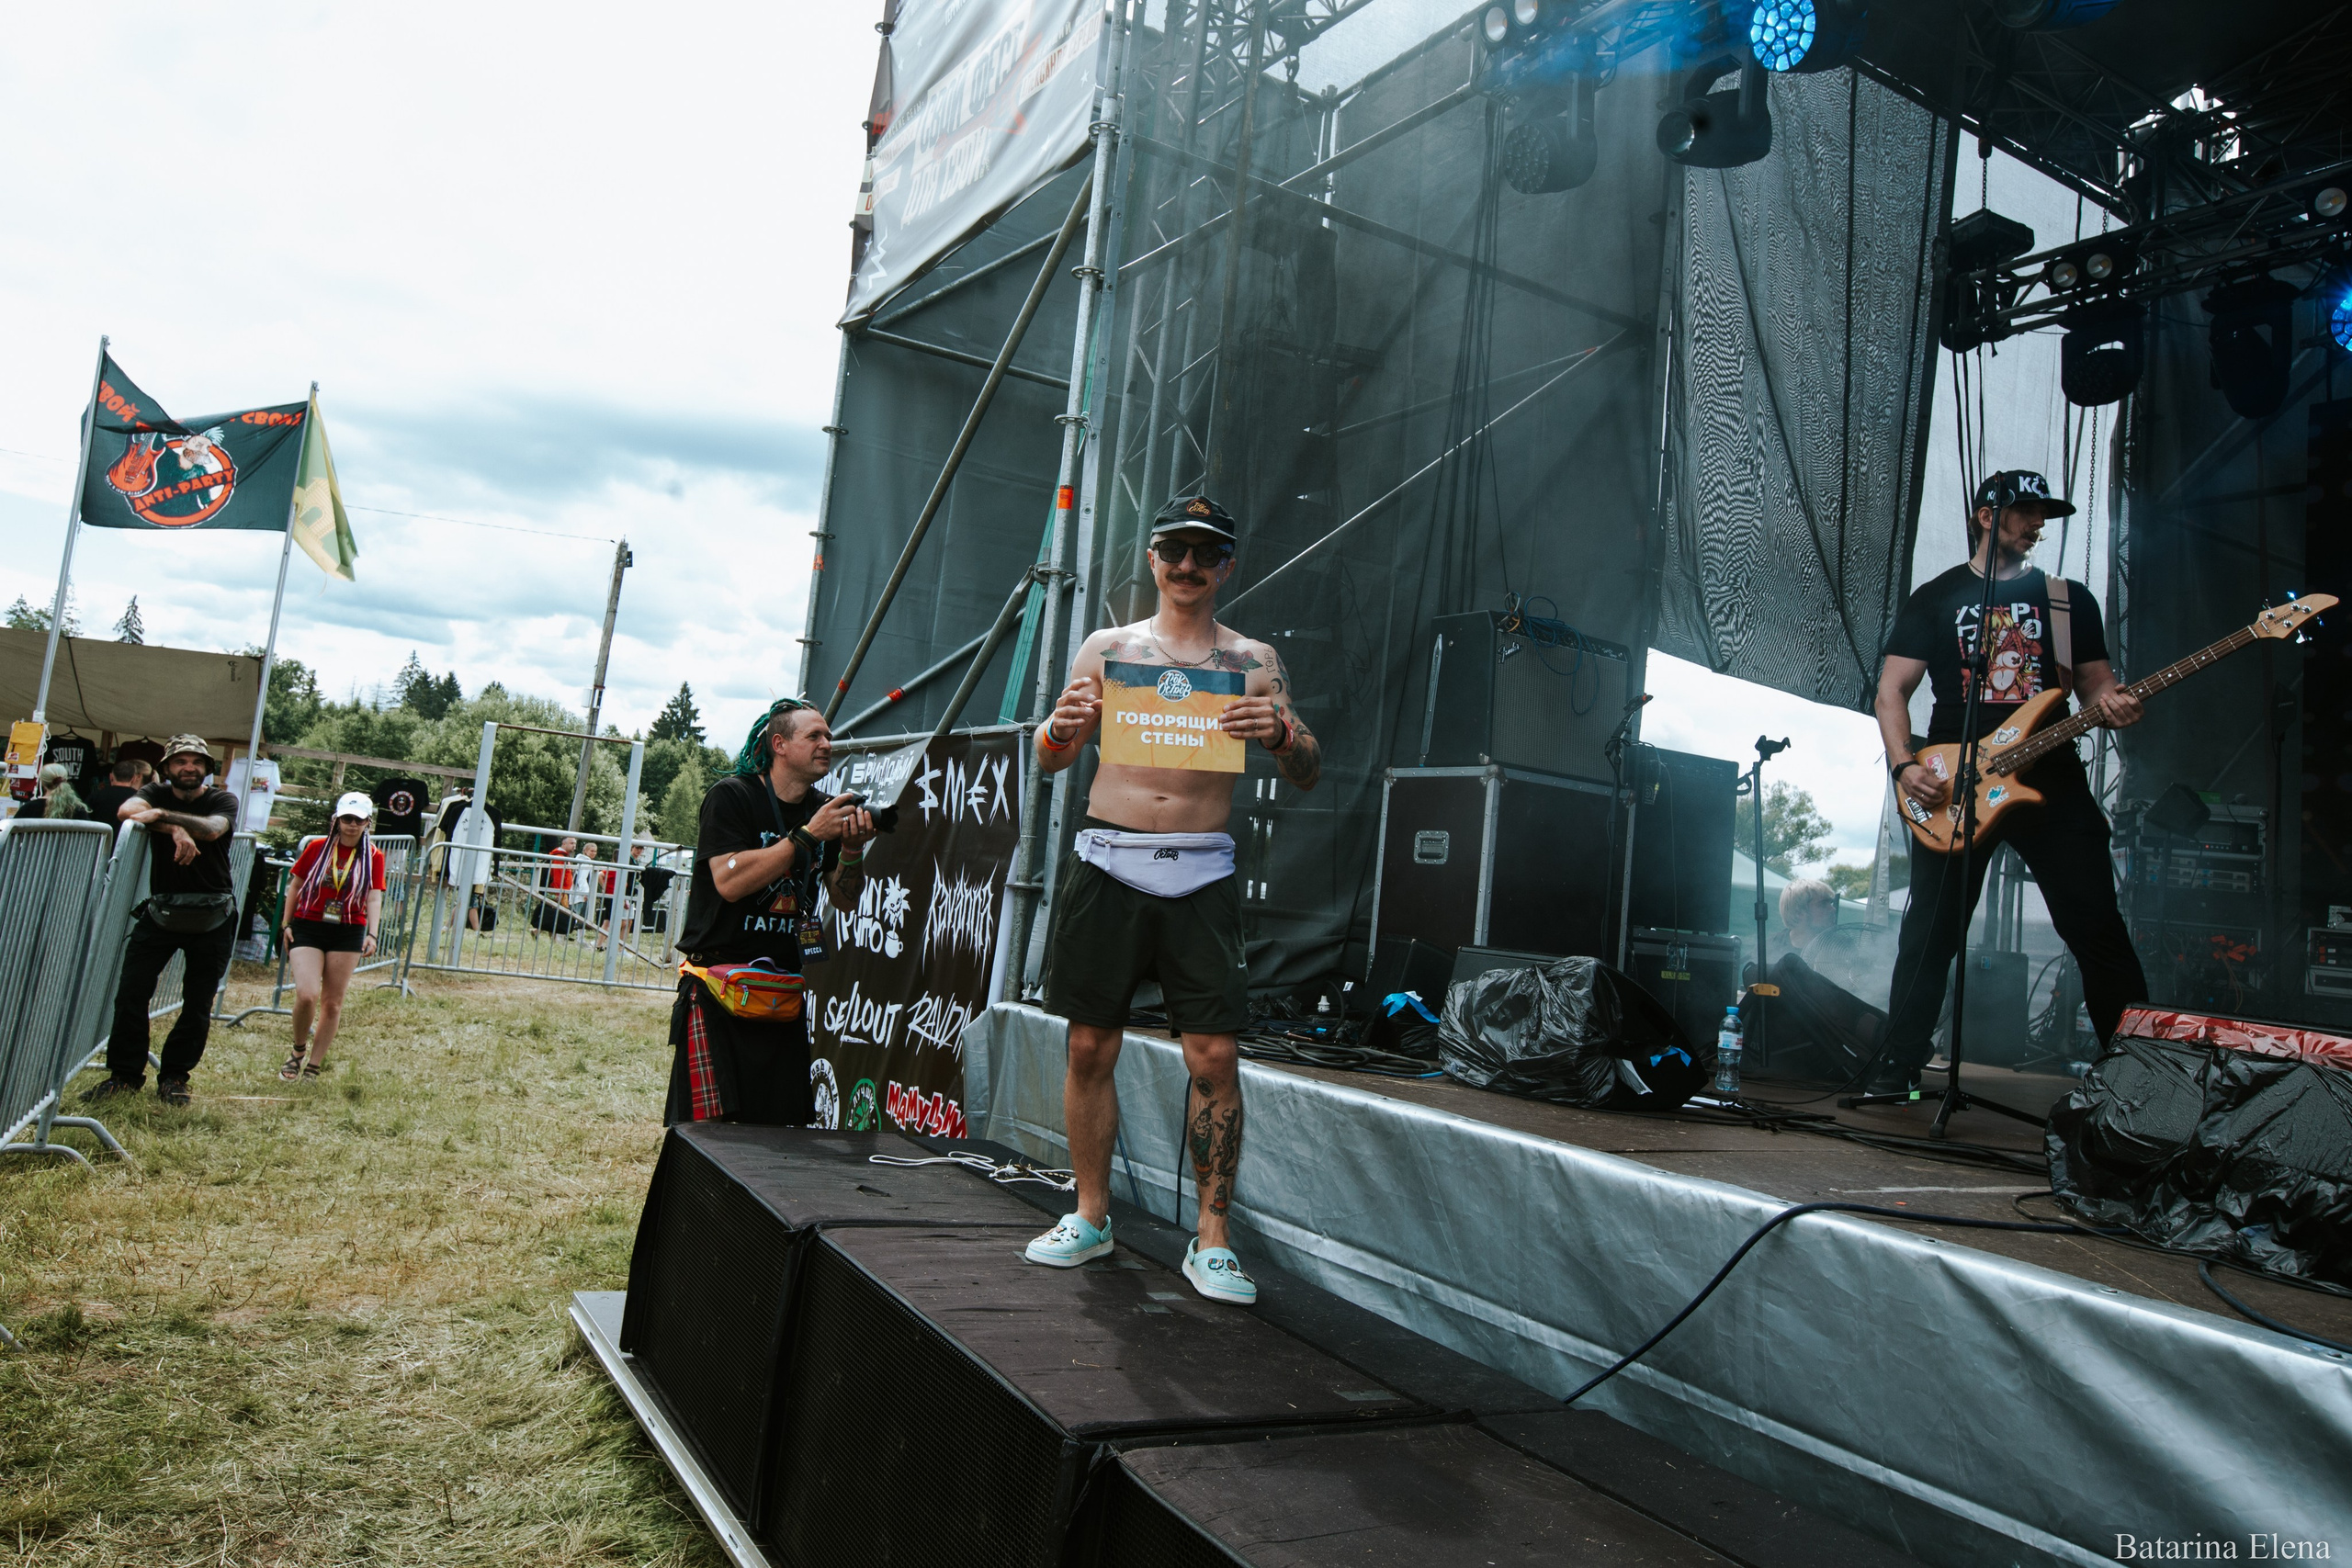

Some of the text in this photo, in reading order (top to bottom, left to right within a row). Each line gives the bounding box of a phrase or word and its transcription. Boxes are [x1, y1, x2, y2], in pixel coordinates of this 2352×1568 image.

[133, 468, 236, 512] ANTI-PARTY
[1116, 711, 1224, 731] ГОВОРЯЩИ
[1140, 731, 1204, 748] СТЕНЫ
[52, 747, 84, 762] SOUTH
[804, 946, 822, 955] ПРЕССА
[824, 980, 903, 1048] SELLOUT
